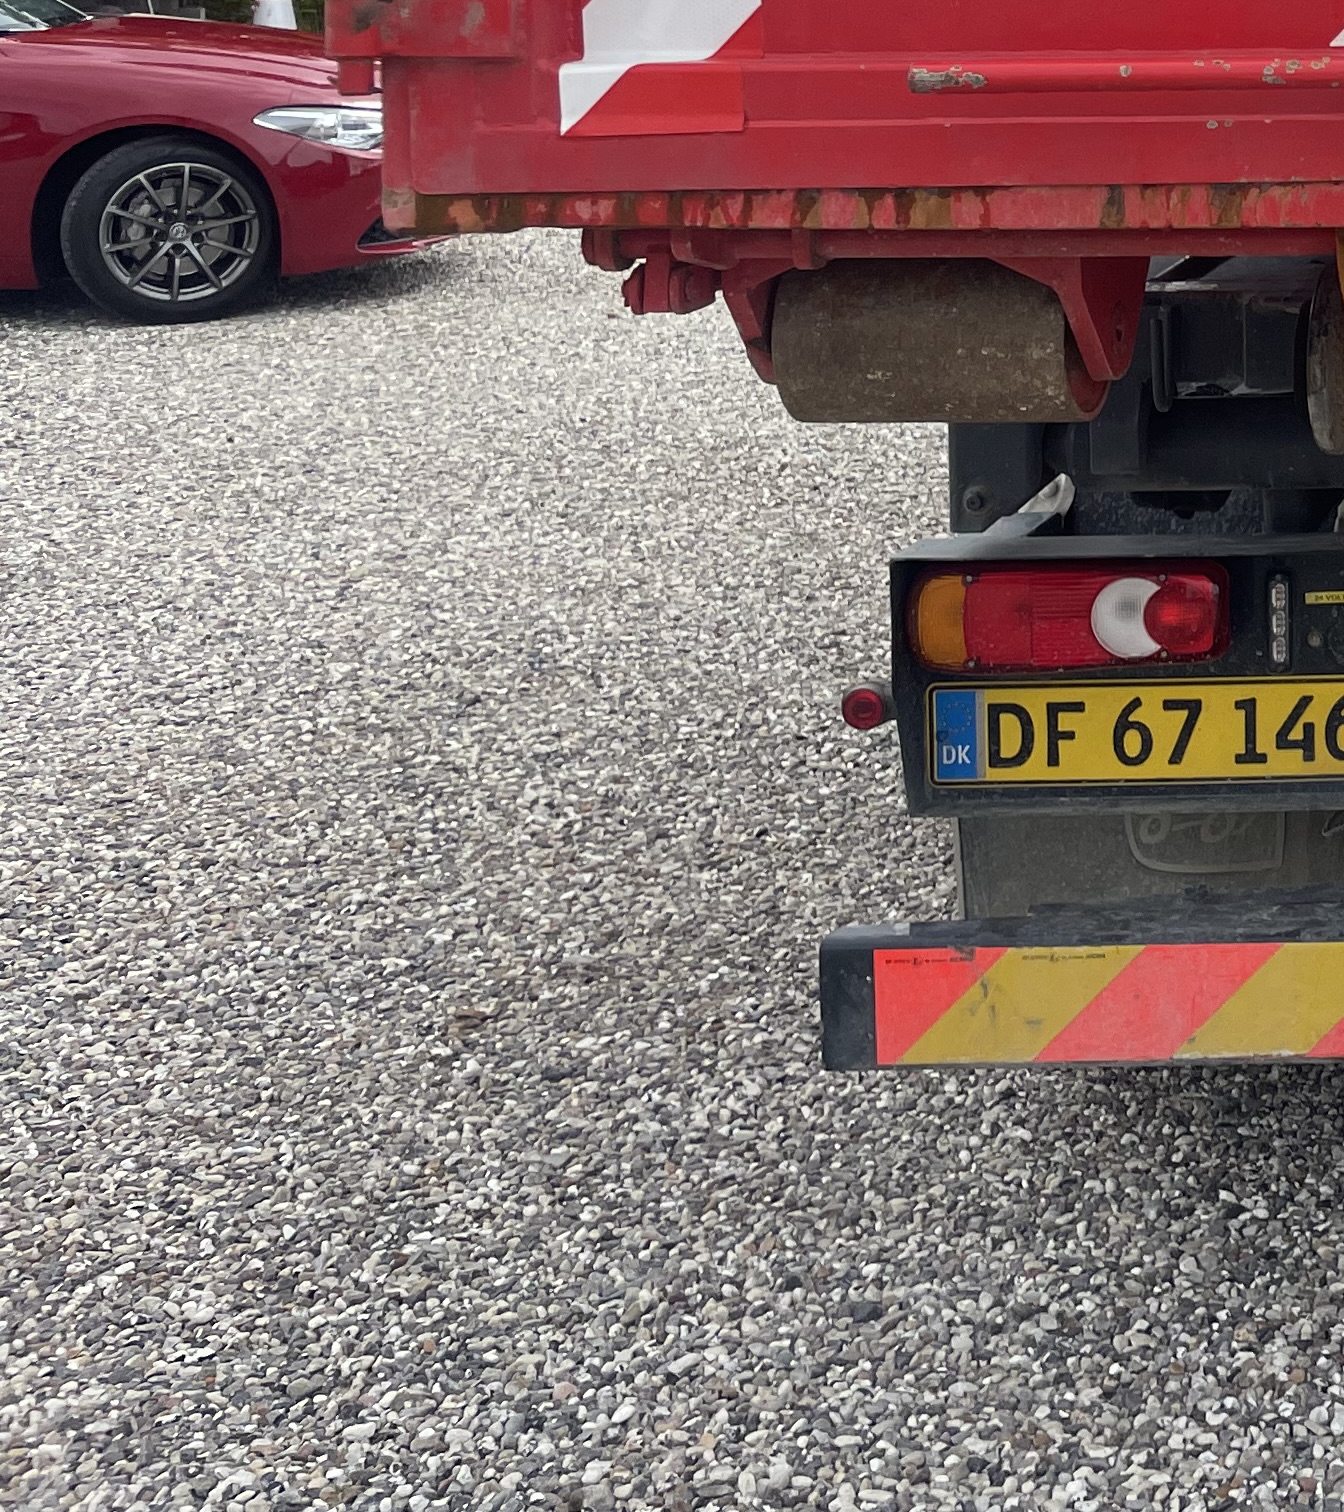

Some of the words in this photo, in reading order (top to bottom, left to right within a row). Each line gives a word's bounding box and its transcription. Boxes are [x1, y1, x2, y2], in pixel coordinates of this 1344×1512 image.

[943, 744, 971, 765] DK
[987, 701, 1085, 769] DF
[1112, 697, 1202, 766] 67
